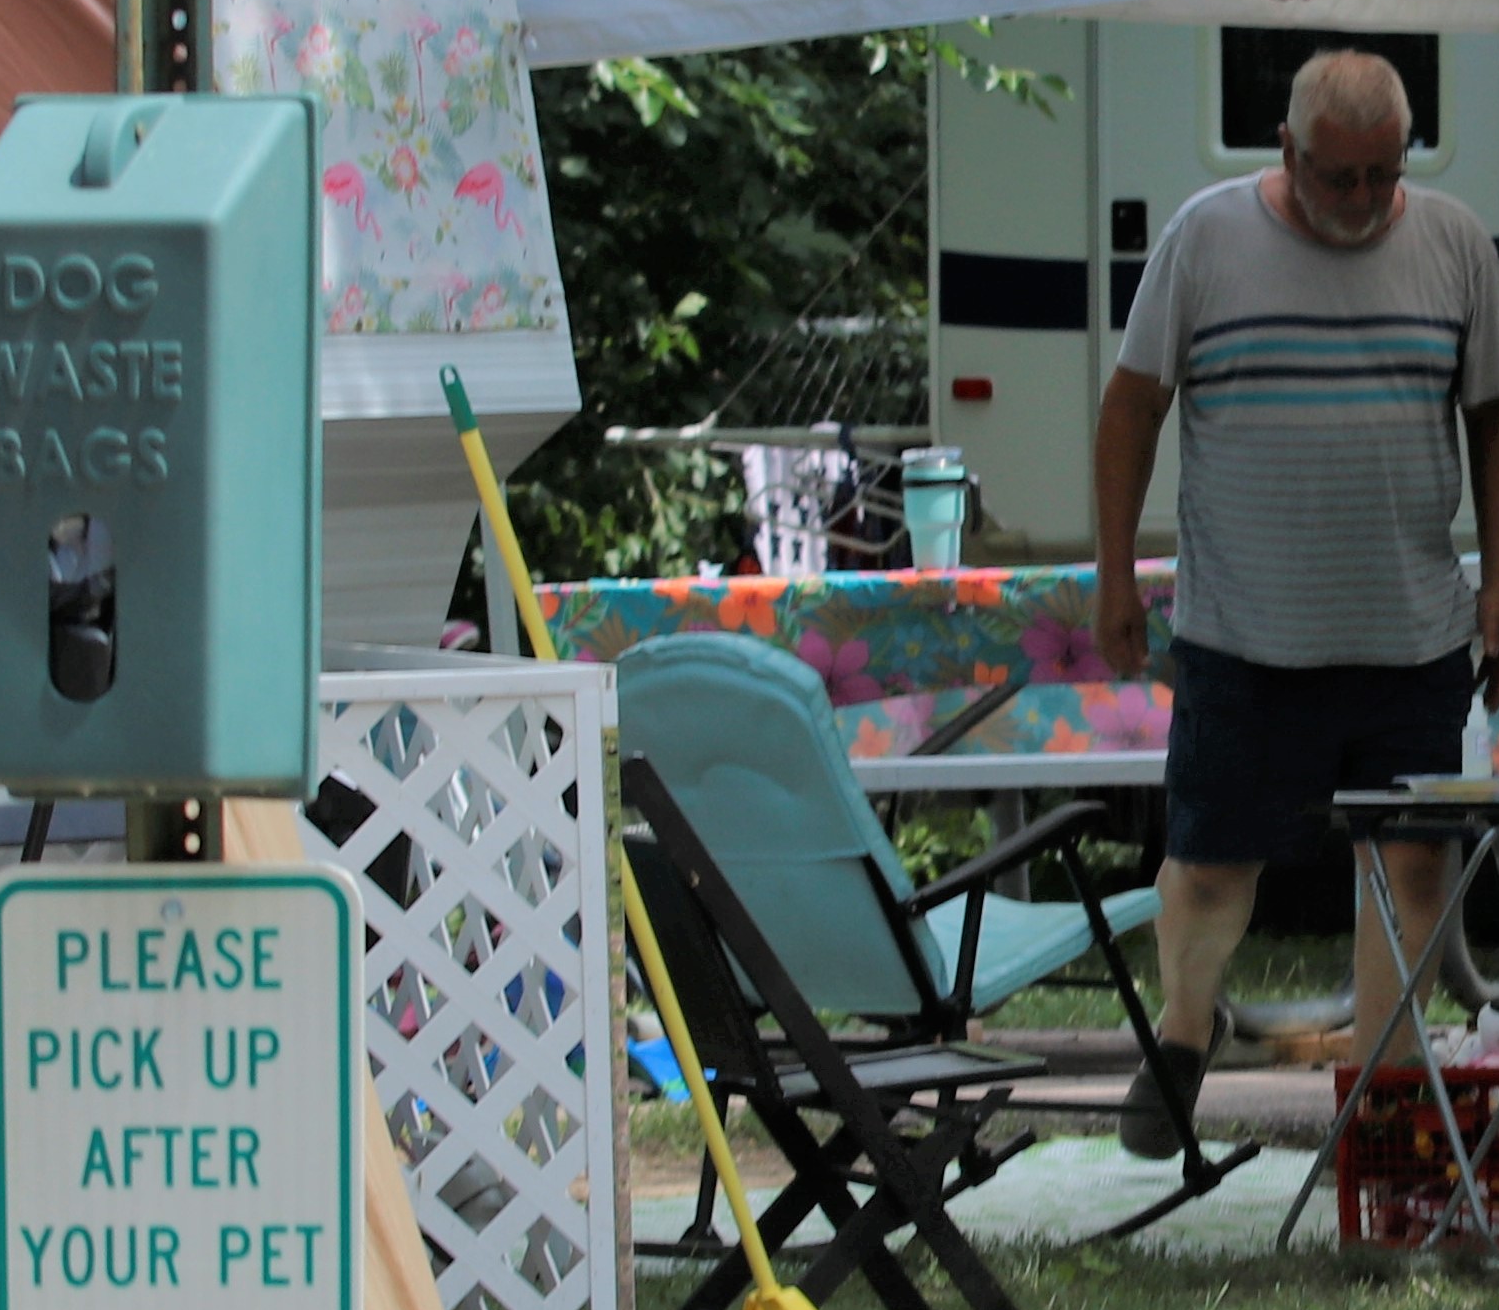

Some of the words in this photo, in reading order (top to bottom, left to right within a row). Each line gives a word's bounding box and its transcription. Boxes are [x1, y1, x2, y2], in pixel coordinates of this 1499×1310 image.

[2, 253, 159, 315] DOG
[57, 928, 282, 991] PLEASE
[27, 1027, 164, 1090] PICK
[204, 1027, 280, 1090] UP
[81, 1127, 260, 1189] AFTER
[20, 1226, 181, 1287] YOUR
[219, 1226, 324, 1286] PET
